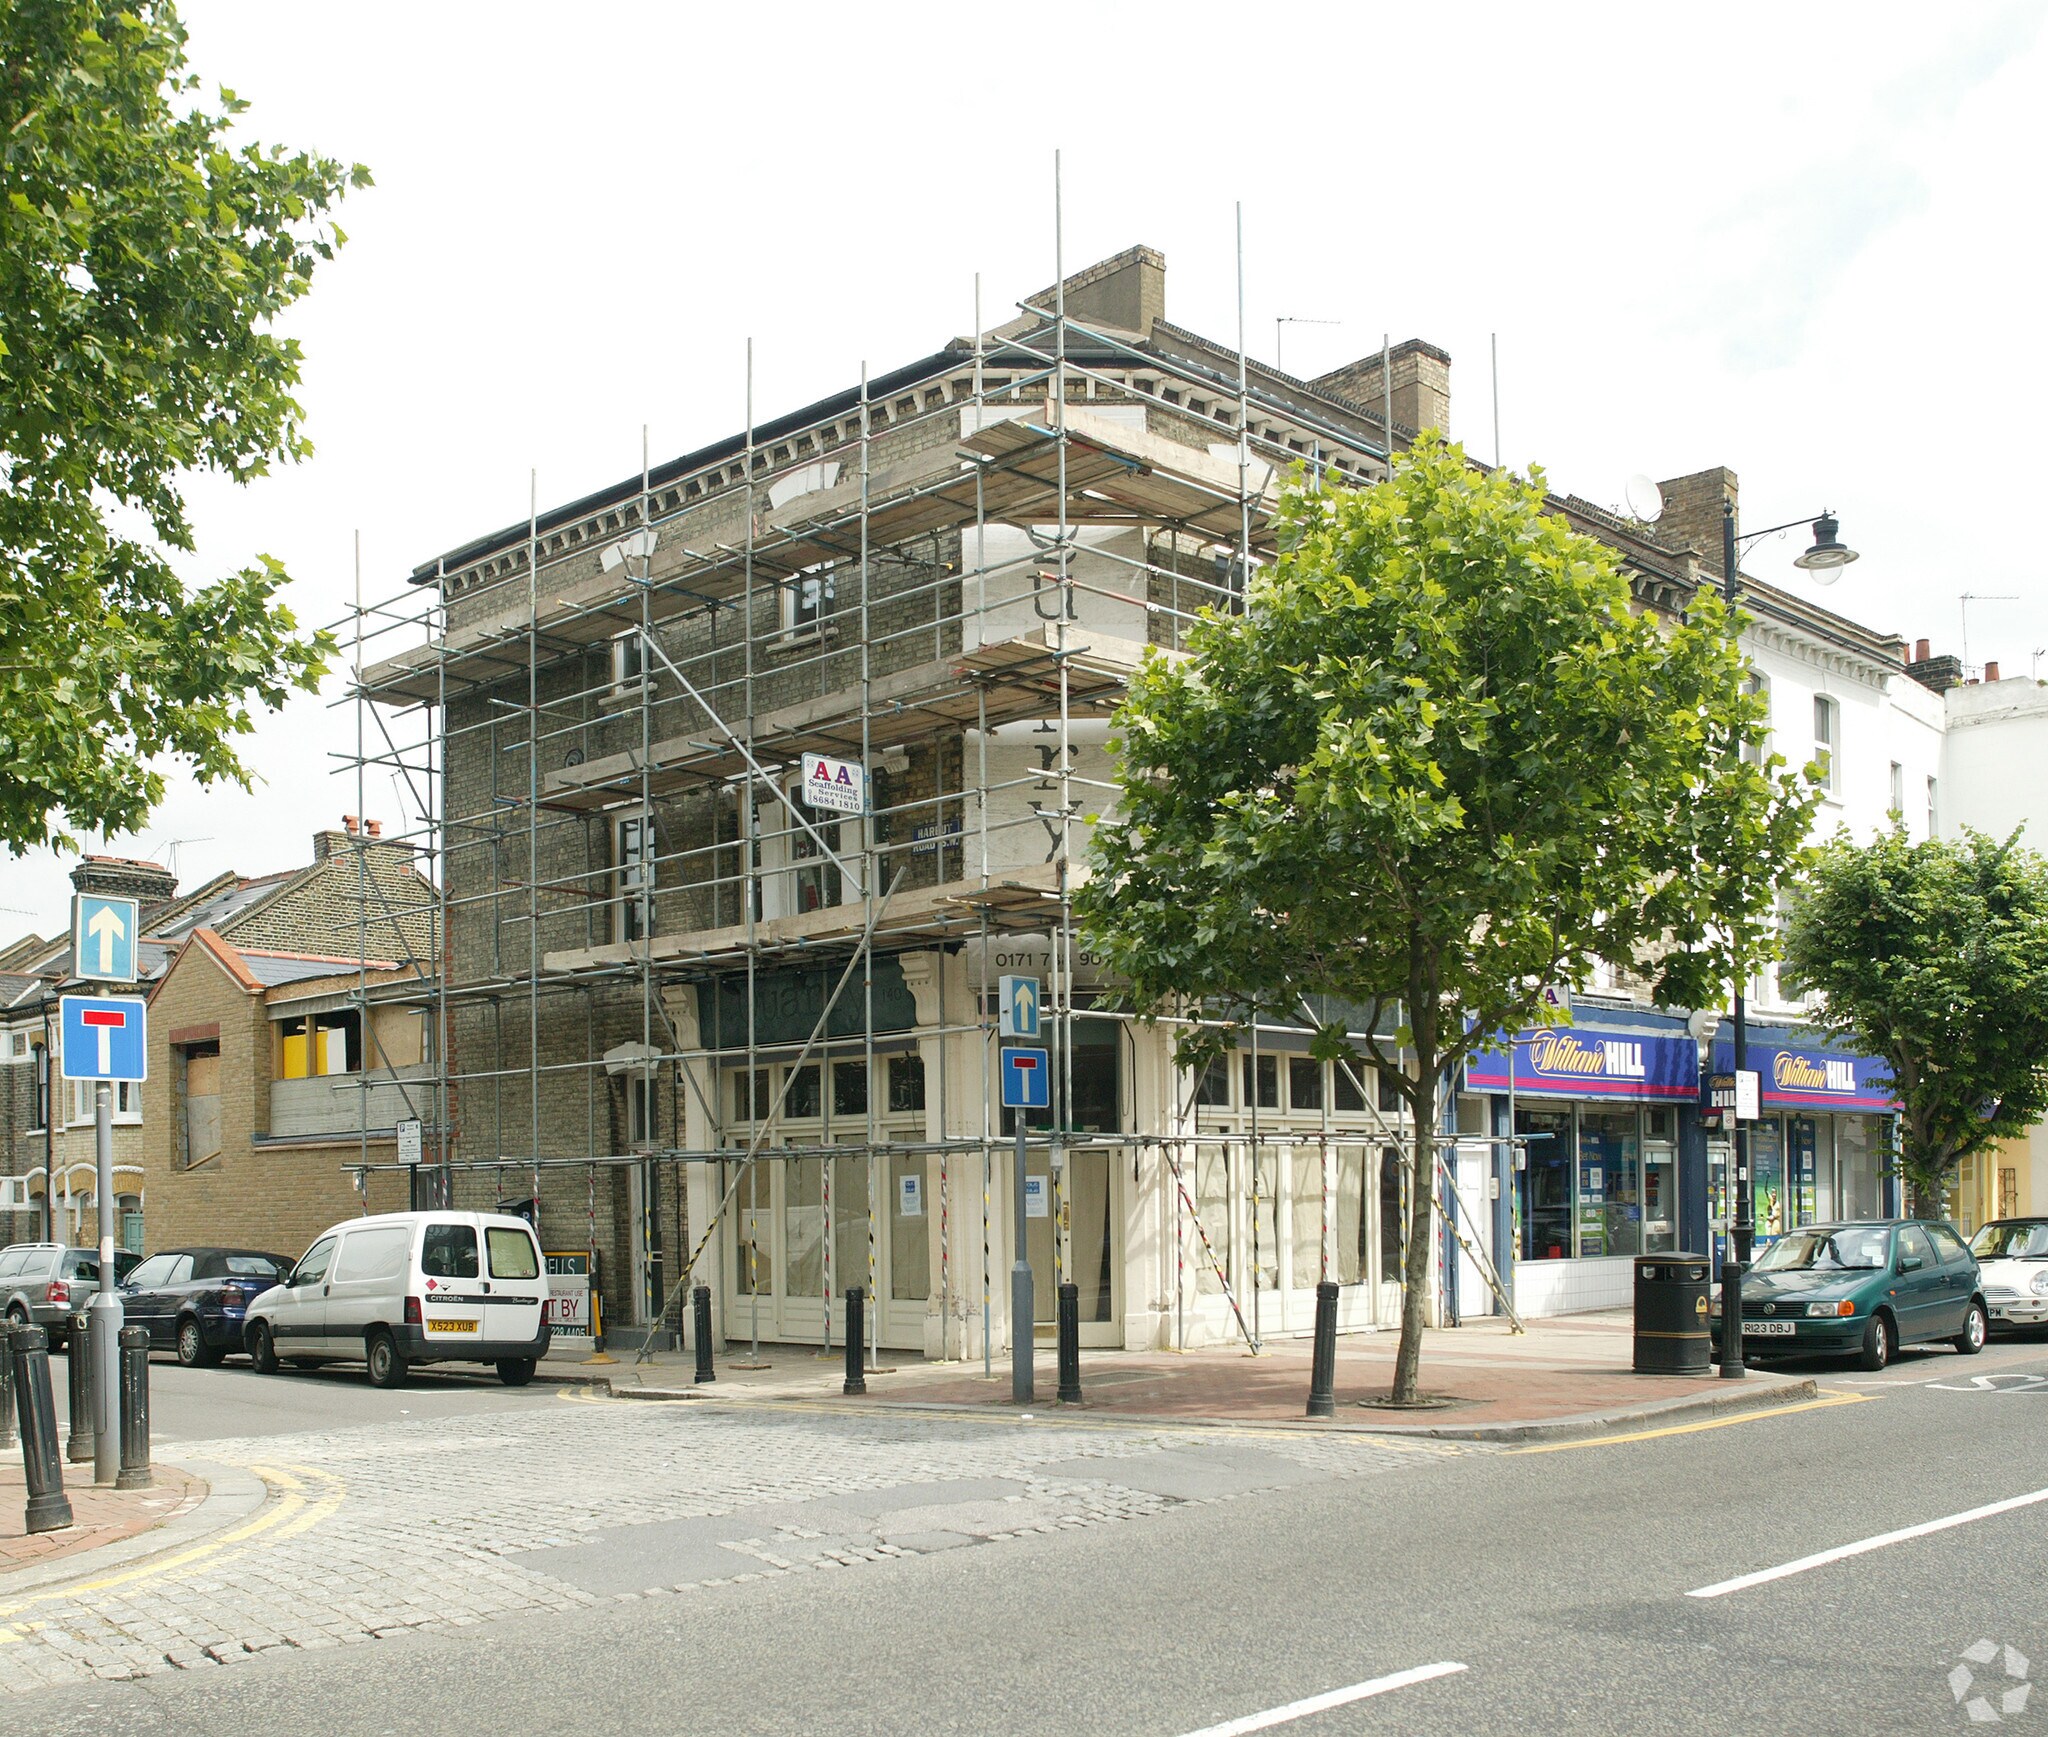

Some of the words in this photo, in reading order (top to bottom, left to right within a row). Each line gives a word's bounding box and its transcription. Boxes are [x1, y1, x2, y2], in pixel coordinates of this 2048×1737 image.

[808, 779, 858, 796] Scaffolding
[818, 789, 858, 802] Services
[813, 795, 834, 806] 8684
[839, 800, 860, 811] 1810
[917, 823, 953, 840] HARUT
[996, 953, 1032, 967] 0171
[1529, 1030, 1606, 1075] William
[1605, 1041, 1645, 1076] HILL
[1773, 1050, 1827, 1090] William
[1827, 1060, 1856, 1090] HILL
[562, 1299, 578, 1317] BY
[432, 1322, 454, 1331] X523
[457, 1322, 474, 1331] XUB
[1769, 1323, 1791, 1333] DBJ
